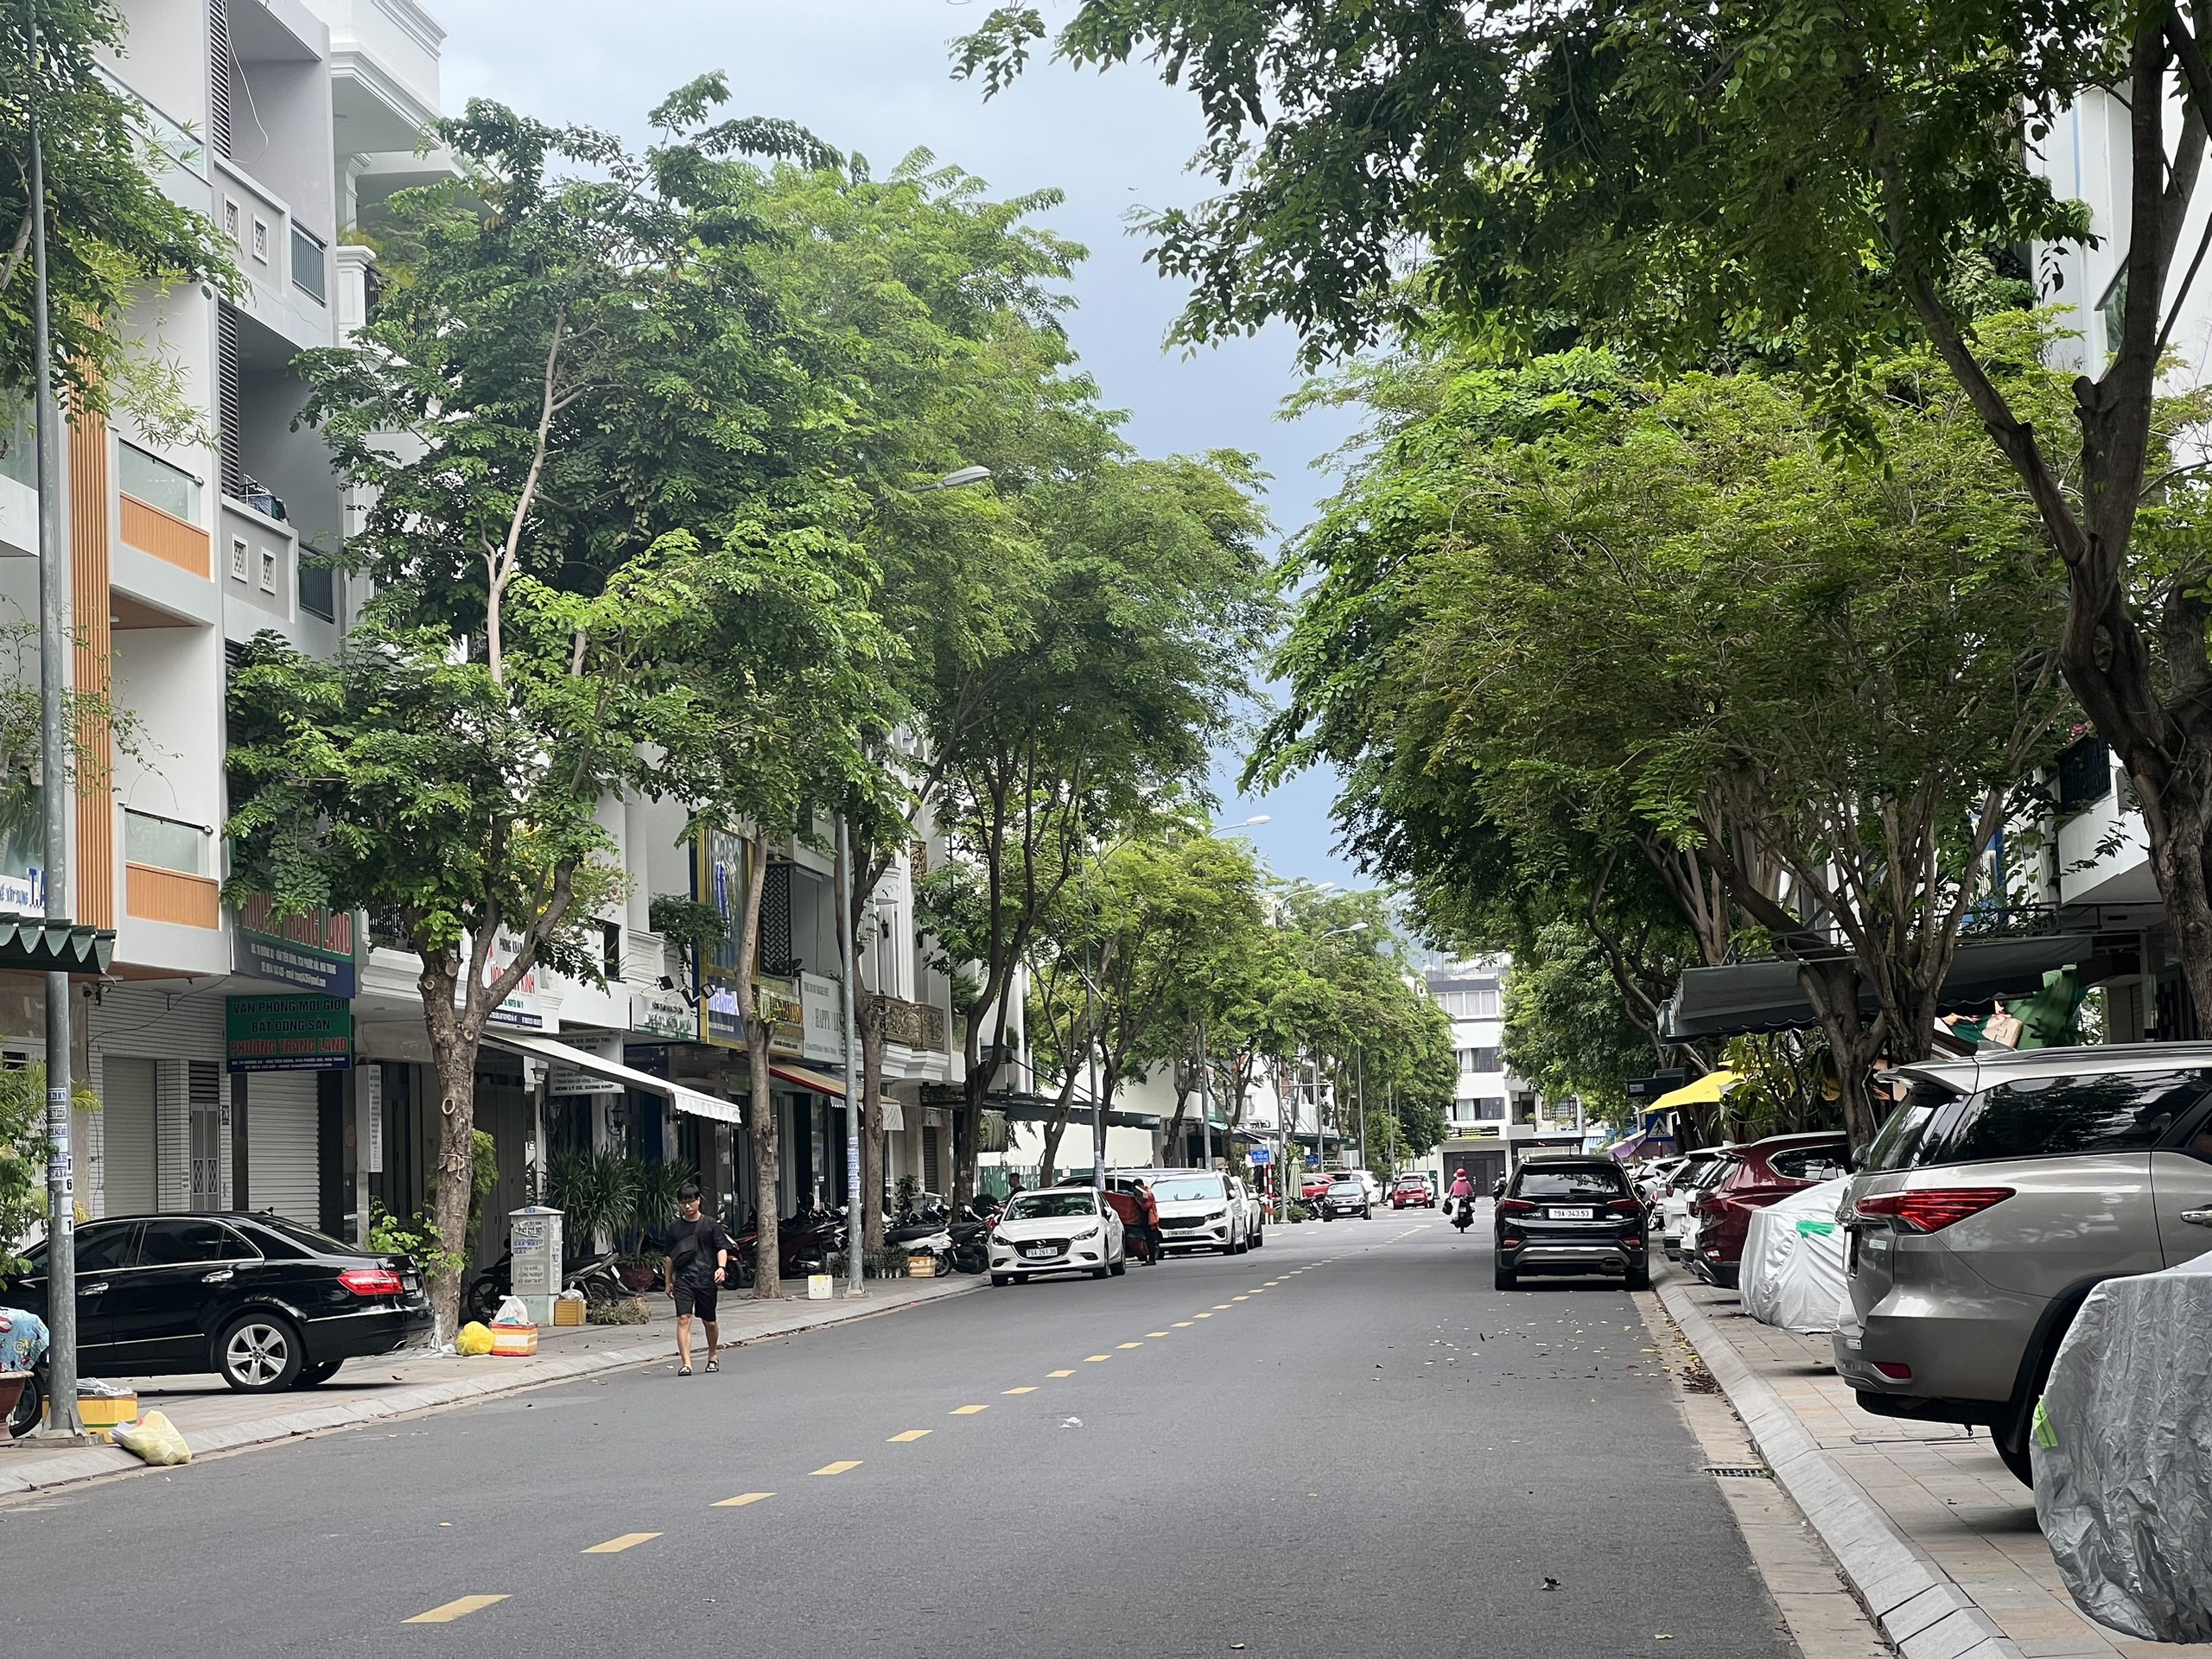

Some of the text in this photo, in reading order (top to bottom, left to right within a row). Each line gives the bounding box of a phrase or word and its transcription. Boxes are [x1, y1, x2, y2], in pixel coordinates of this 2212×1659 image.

[278, 1038, 316, 1054] TRANG
[319, 1037, 348, 1052] LAND
[67, 1179, 73, 1191] 6
[67, 1219, 72, 1232] 1
